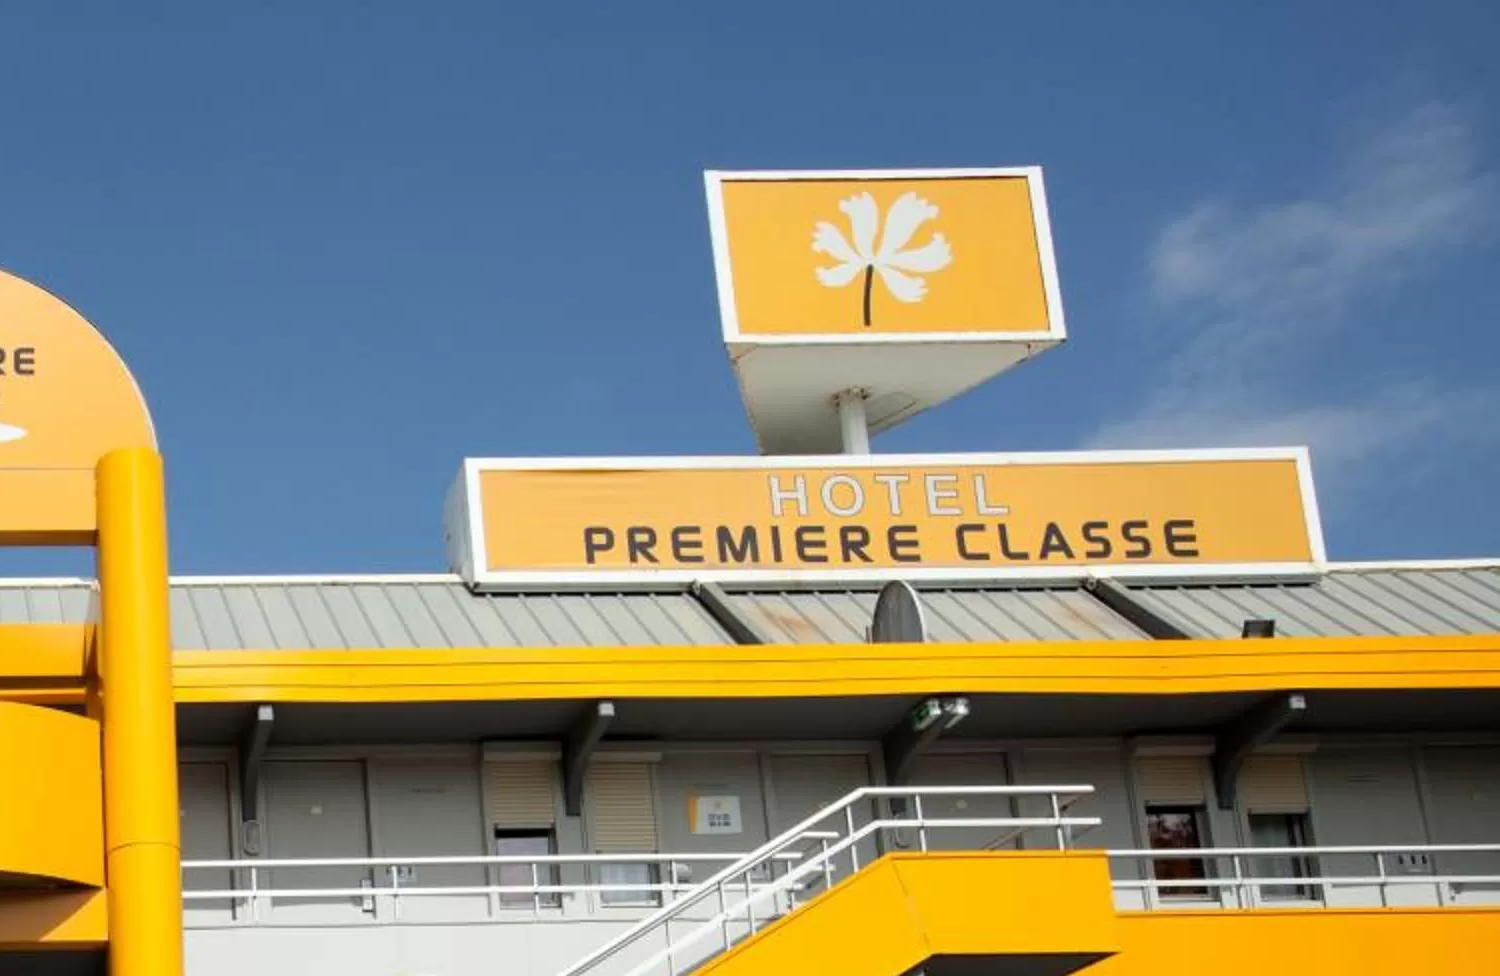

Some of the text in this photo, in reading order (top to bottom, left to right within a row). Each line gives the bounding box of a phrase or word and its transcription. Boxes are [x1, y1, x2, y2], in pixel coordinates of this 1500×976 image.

[769, 474, 1010, 518] HOTEL
[583, 519, 1200, 565] PREMIERE CLASSE
